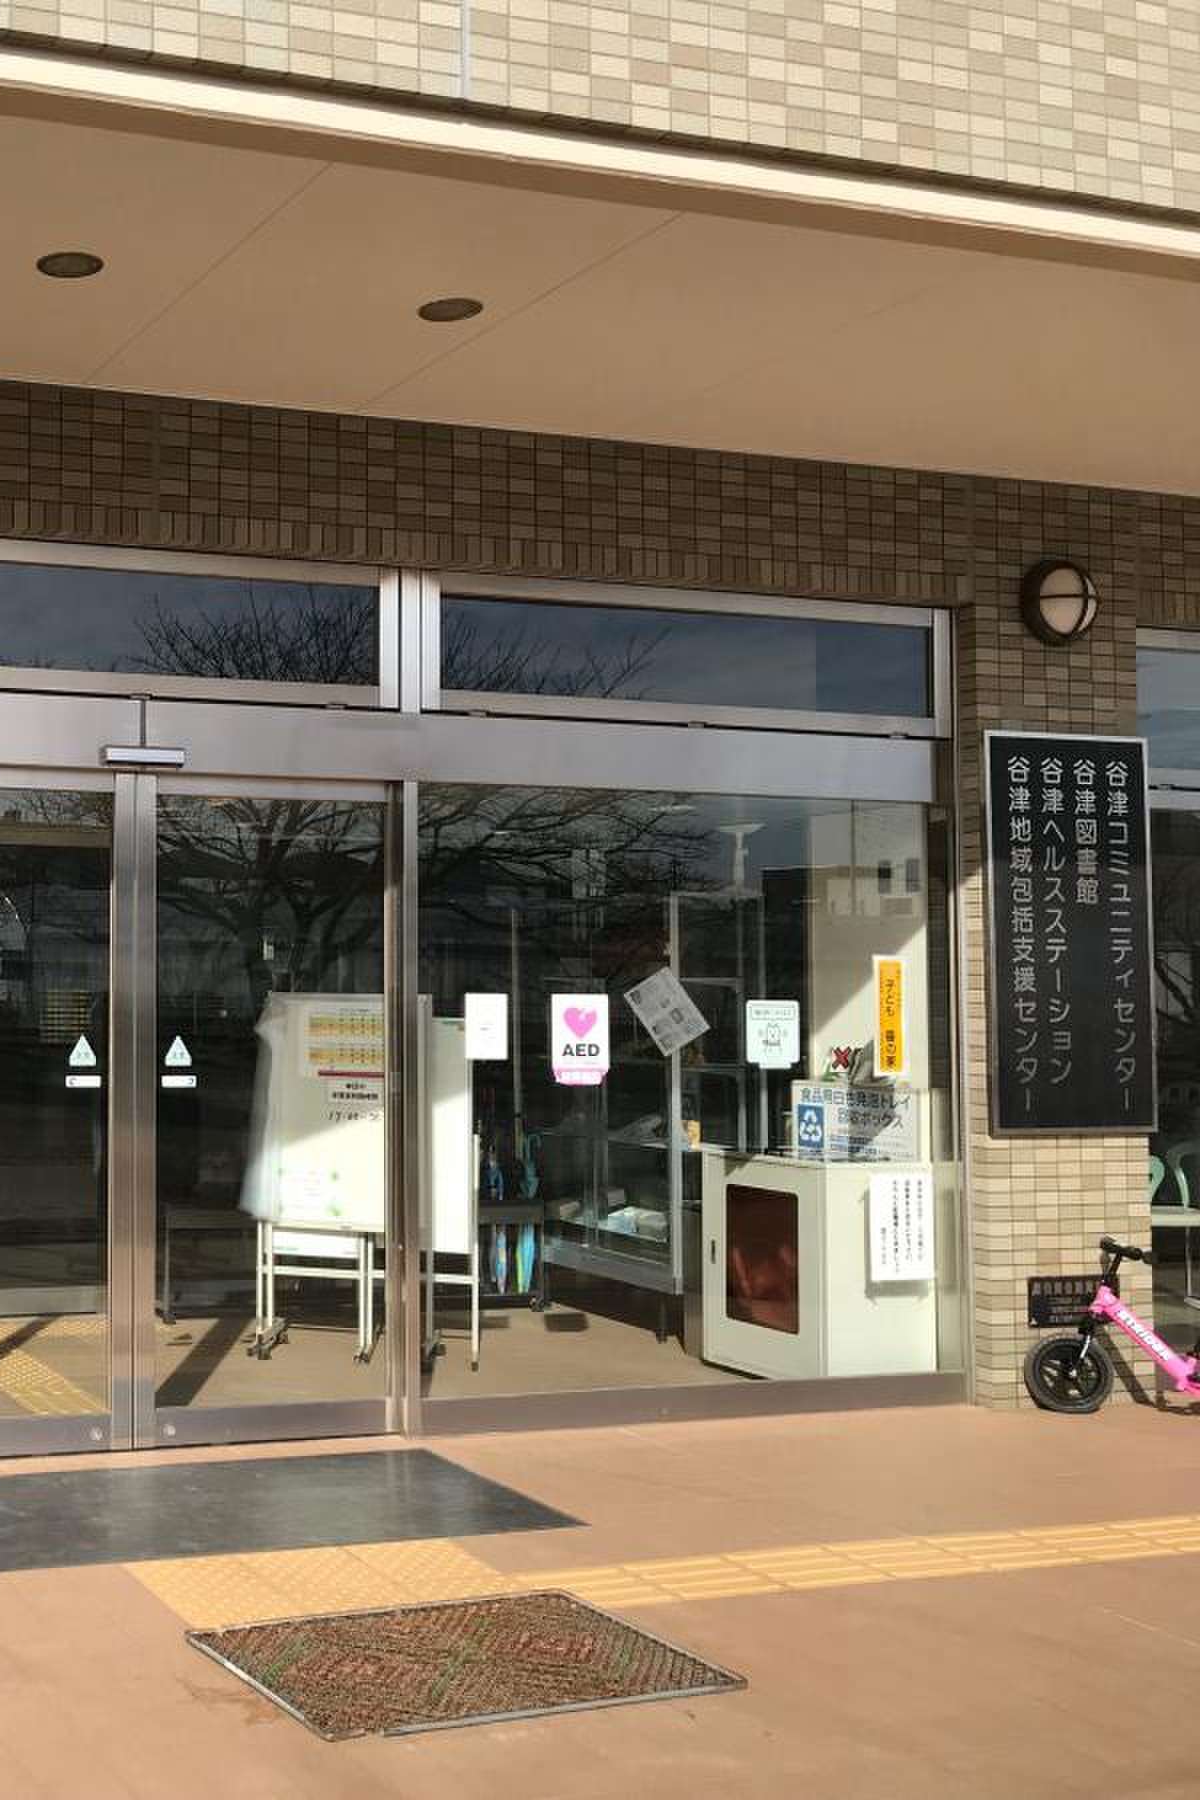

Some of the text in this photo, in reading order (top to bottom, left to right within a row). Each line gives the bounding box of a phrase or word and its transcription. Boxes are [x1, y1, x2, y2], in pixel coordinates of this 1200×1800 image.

[1007, 755, 1040, 1112] 谷津地域包括支援センター
[1040, 757, 1072, 1085] 谷津ヘルスステーション
[1073, 758, 1098, 905] 谷津図書館
[1105, 760, 1137, 1111] 谷津コミュニティセンター
[562, 1044, 600, 1057] AED
